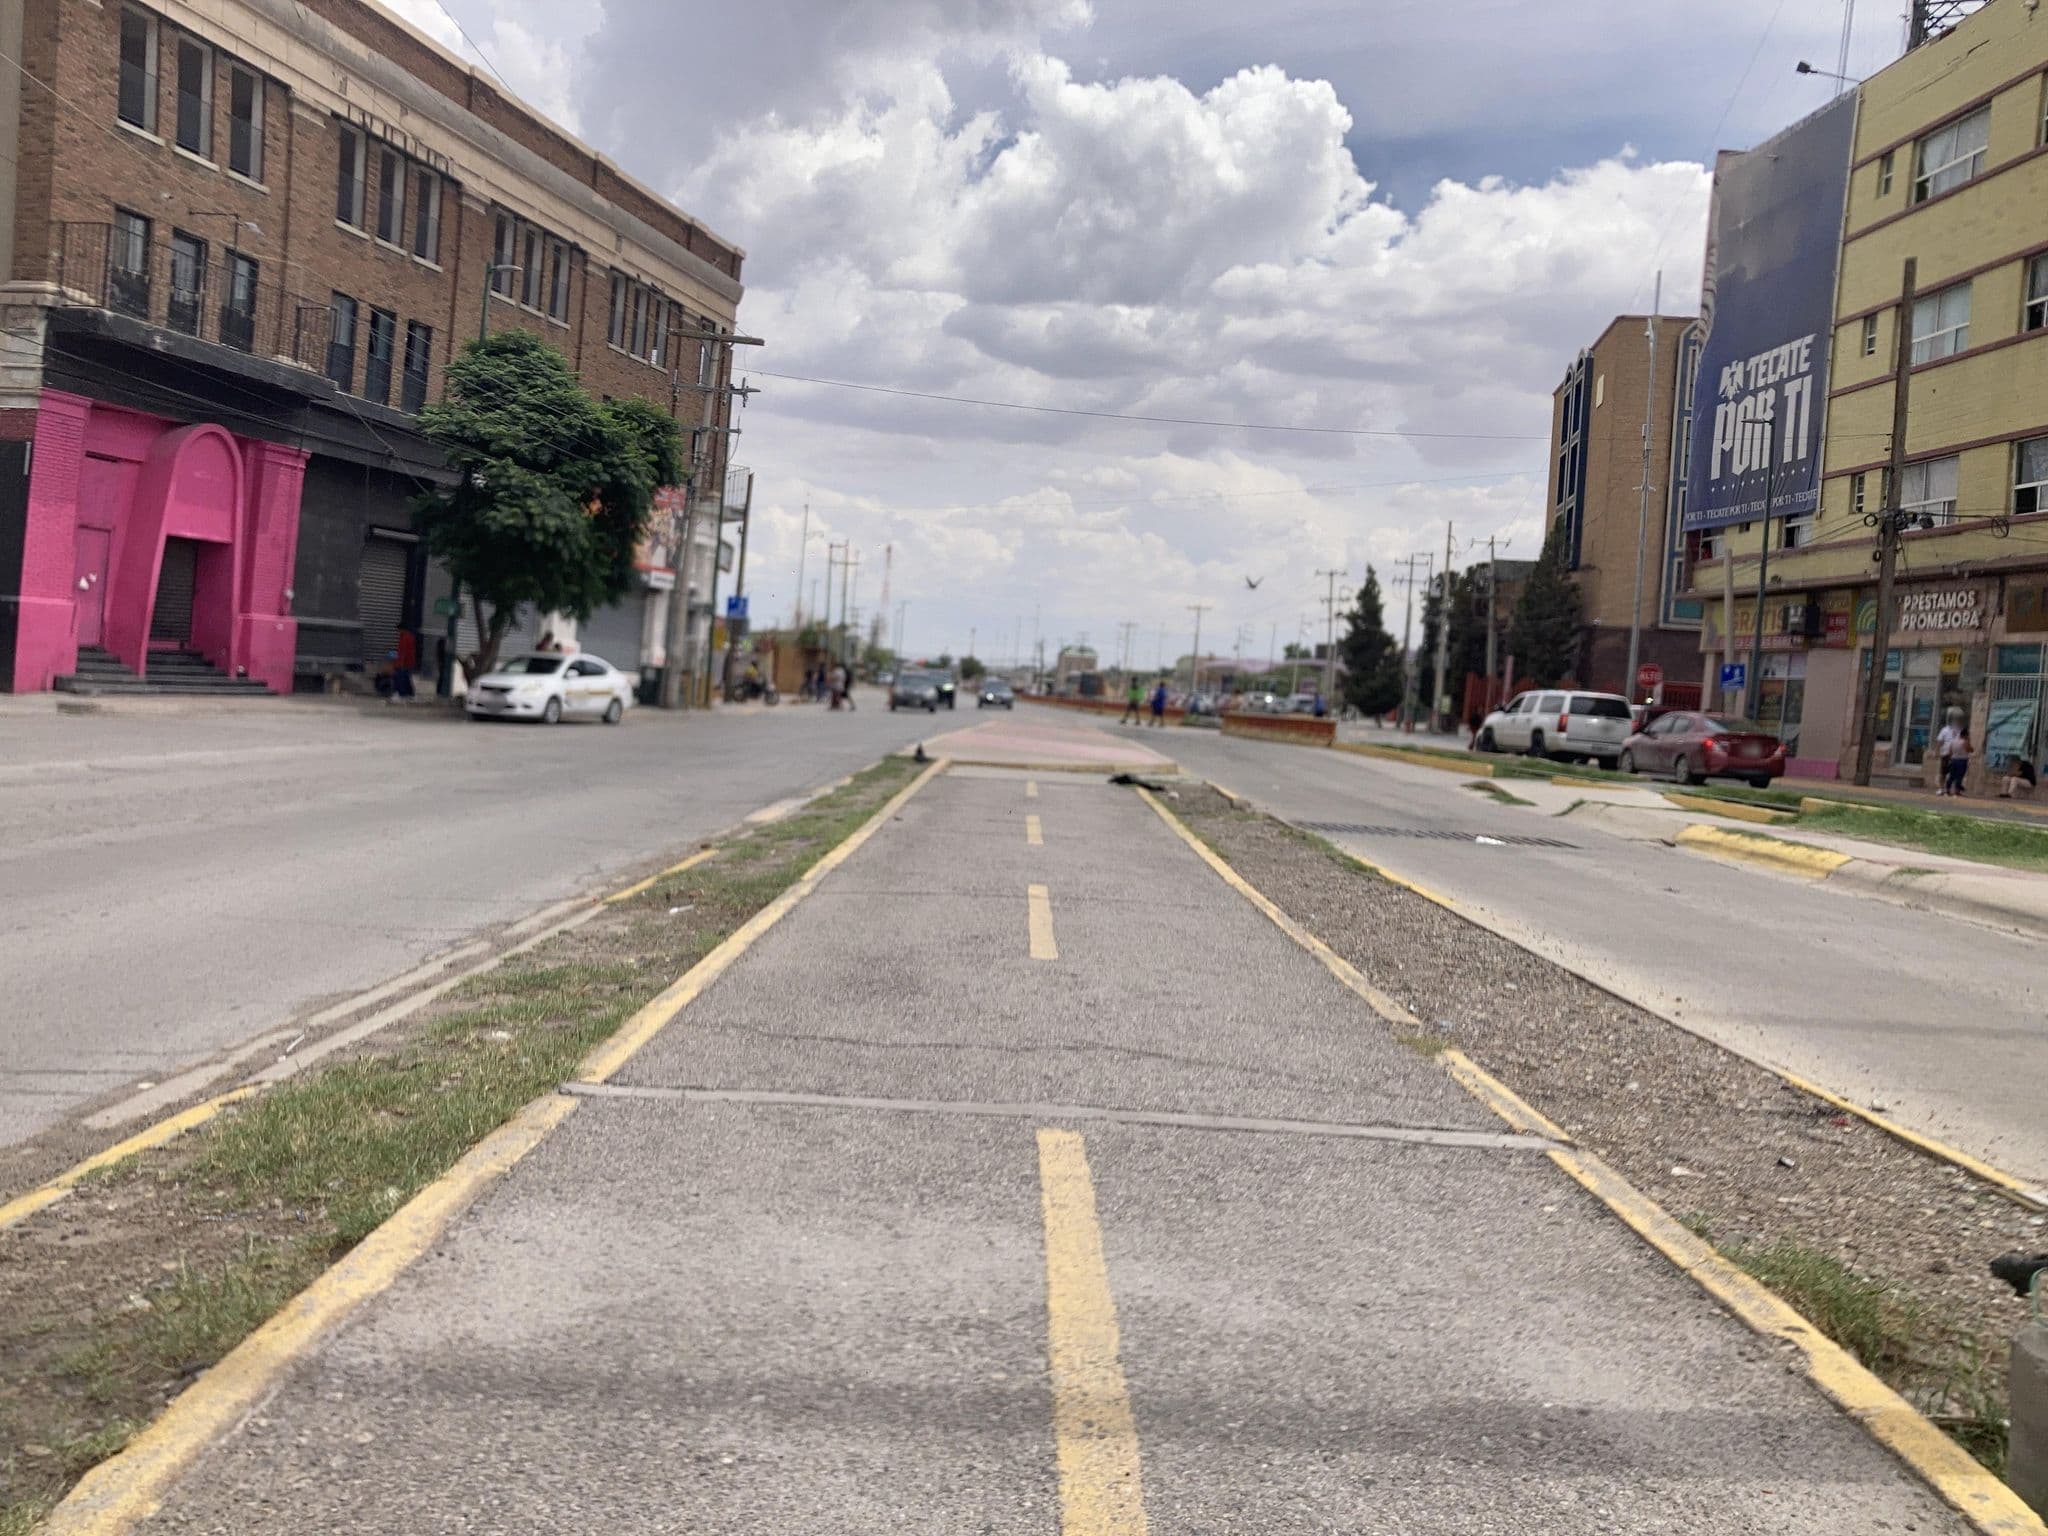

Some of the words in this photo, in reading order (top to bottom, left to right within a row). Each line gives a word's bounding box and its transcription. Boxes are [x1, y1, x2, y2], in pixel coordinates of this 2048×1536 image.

[1747, 334, 1817, 390] TECATE
[1711, 387, 1776, 481] POR
[1783, 374, 1813, 464] TI
[1707, 507, 1729, 519] TECATE
[1795, 488, 1818, 503] TECATE
[1902, 611, 1979, 630] PROMEJORA
